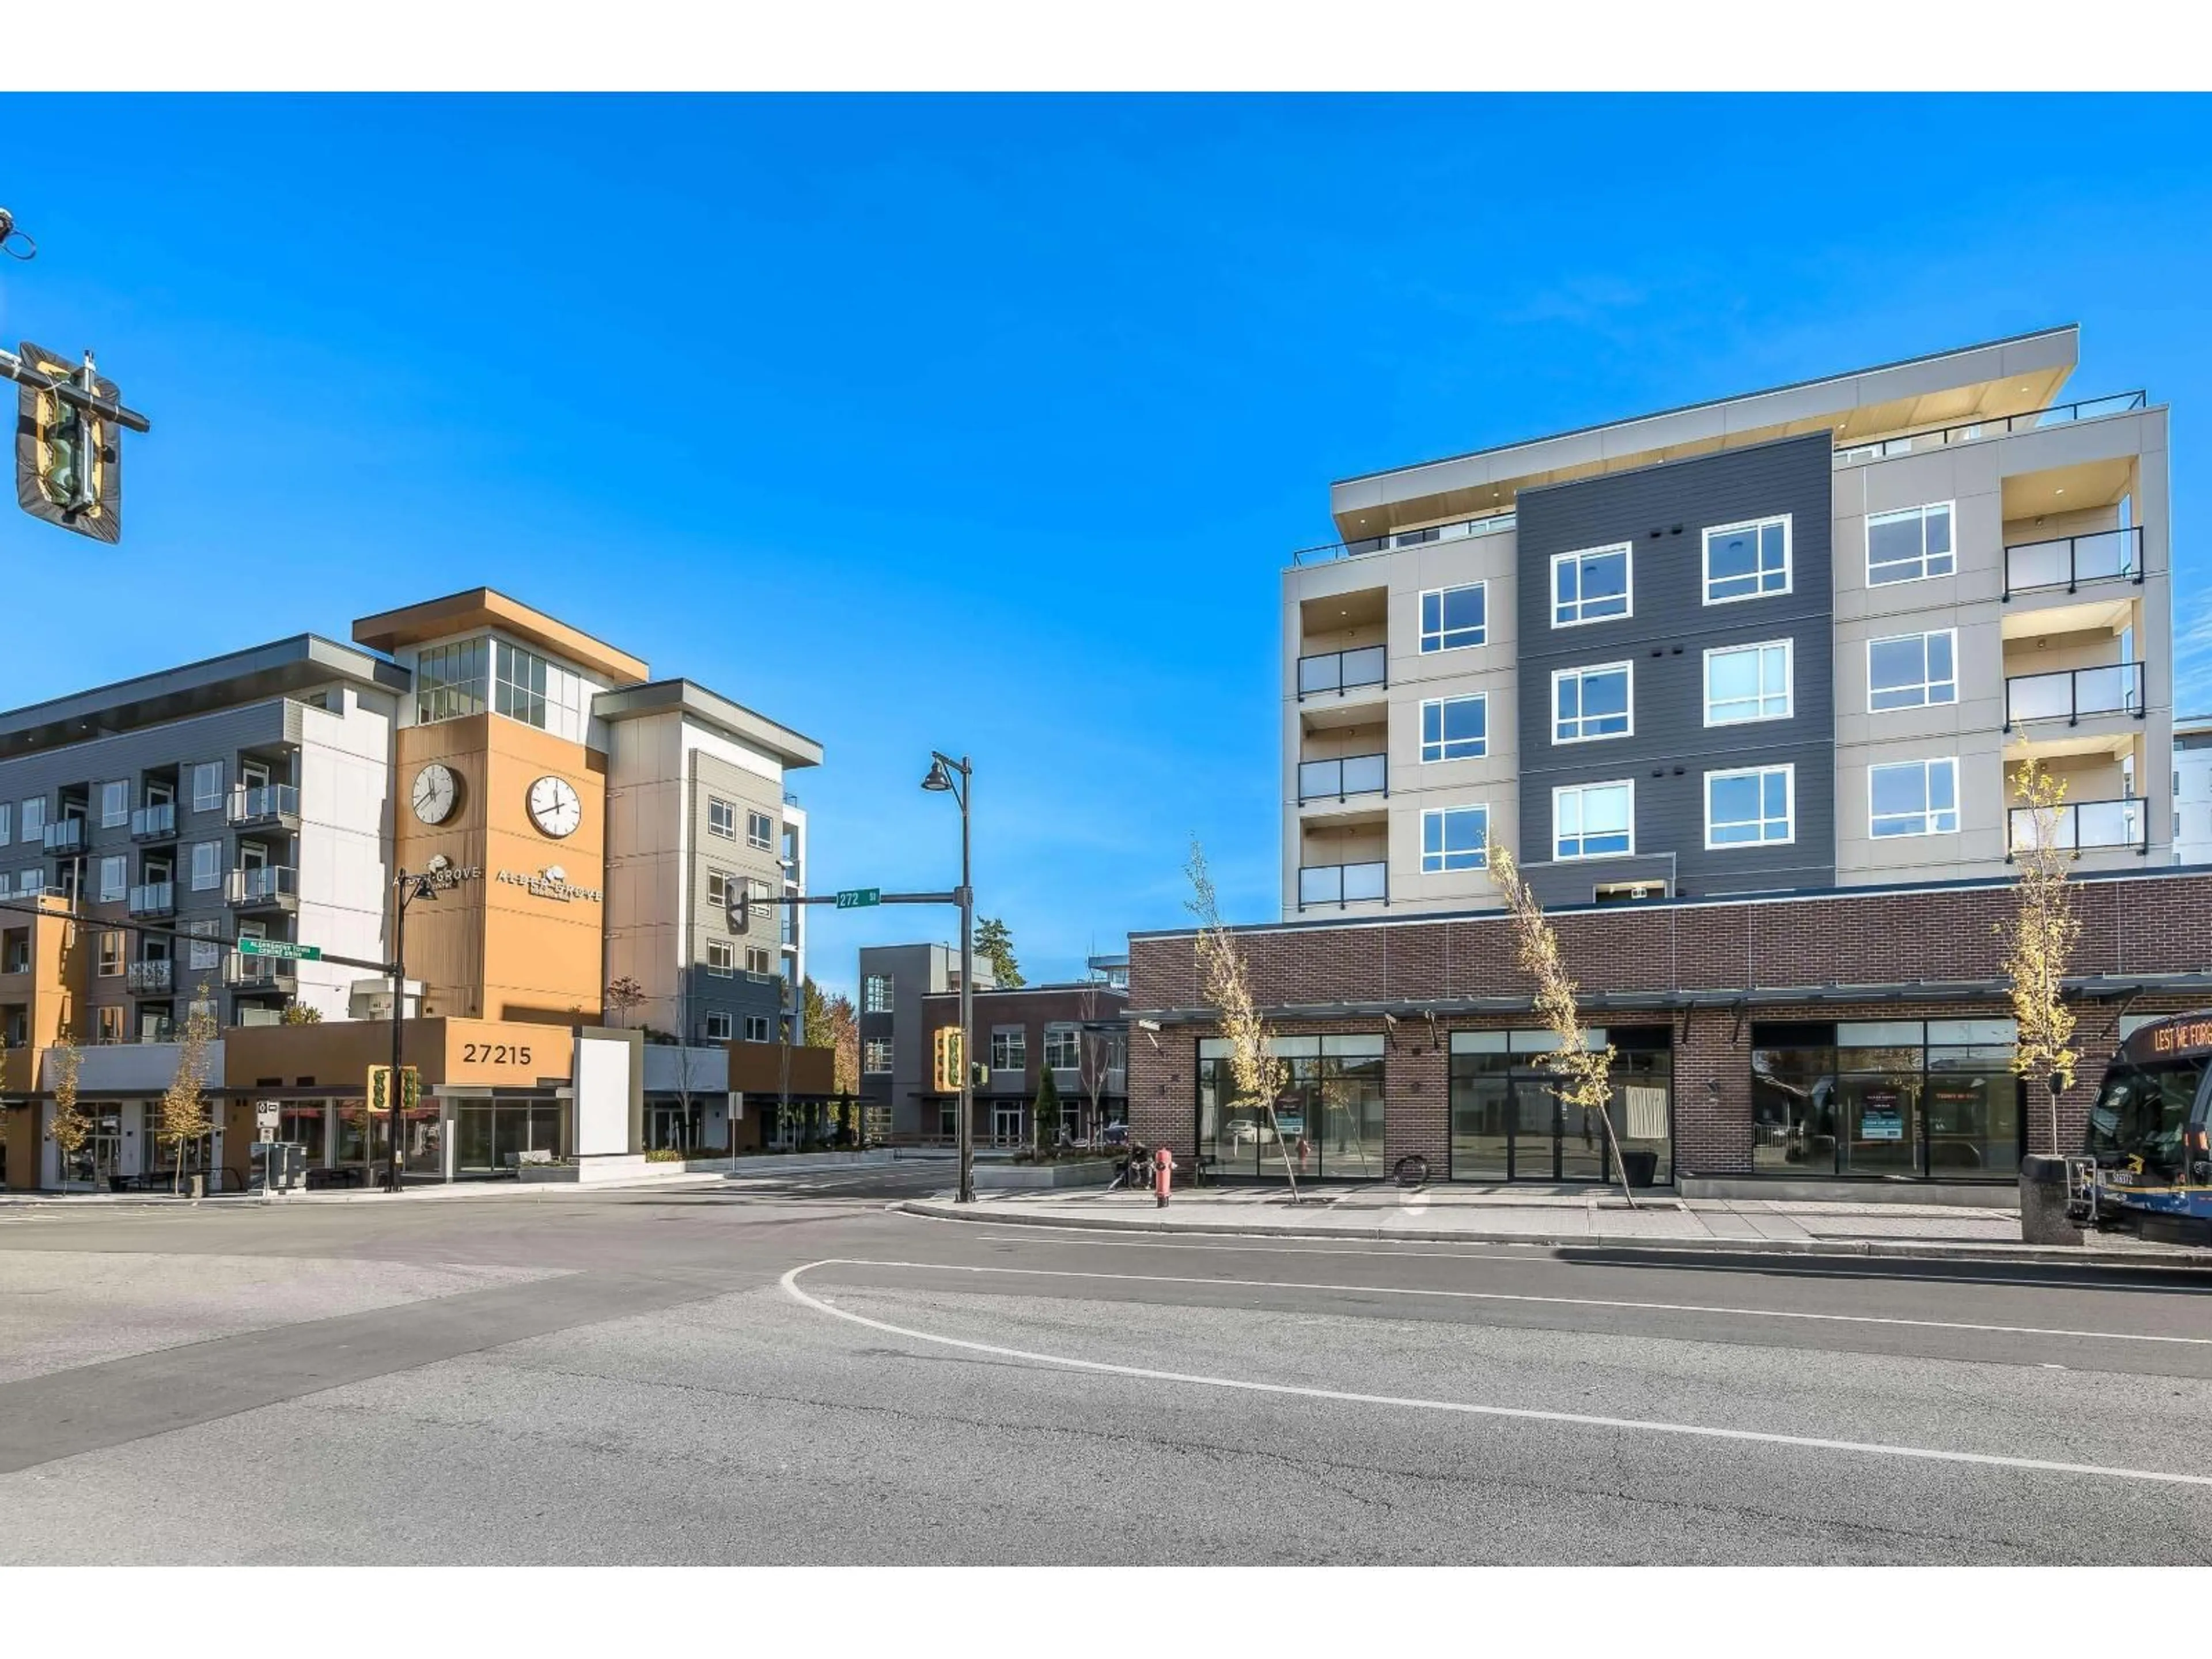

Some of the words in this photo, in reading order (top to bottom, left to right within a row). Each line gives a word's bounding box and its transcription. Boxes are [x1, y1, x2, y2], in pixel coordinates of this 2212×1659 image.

[840, 892, 858, 906] 272
[2155, 1028, 2174, 1051] LEST
[2176, 1026, 2188, 1048] WE
[463, 1043, 531, 1065] 27215
